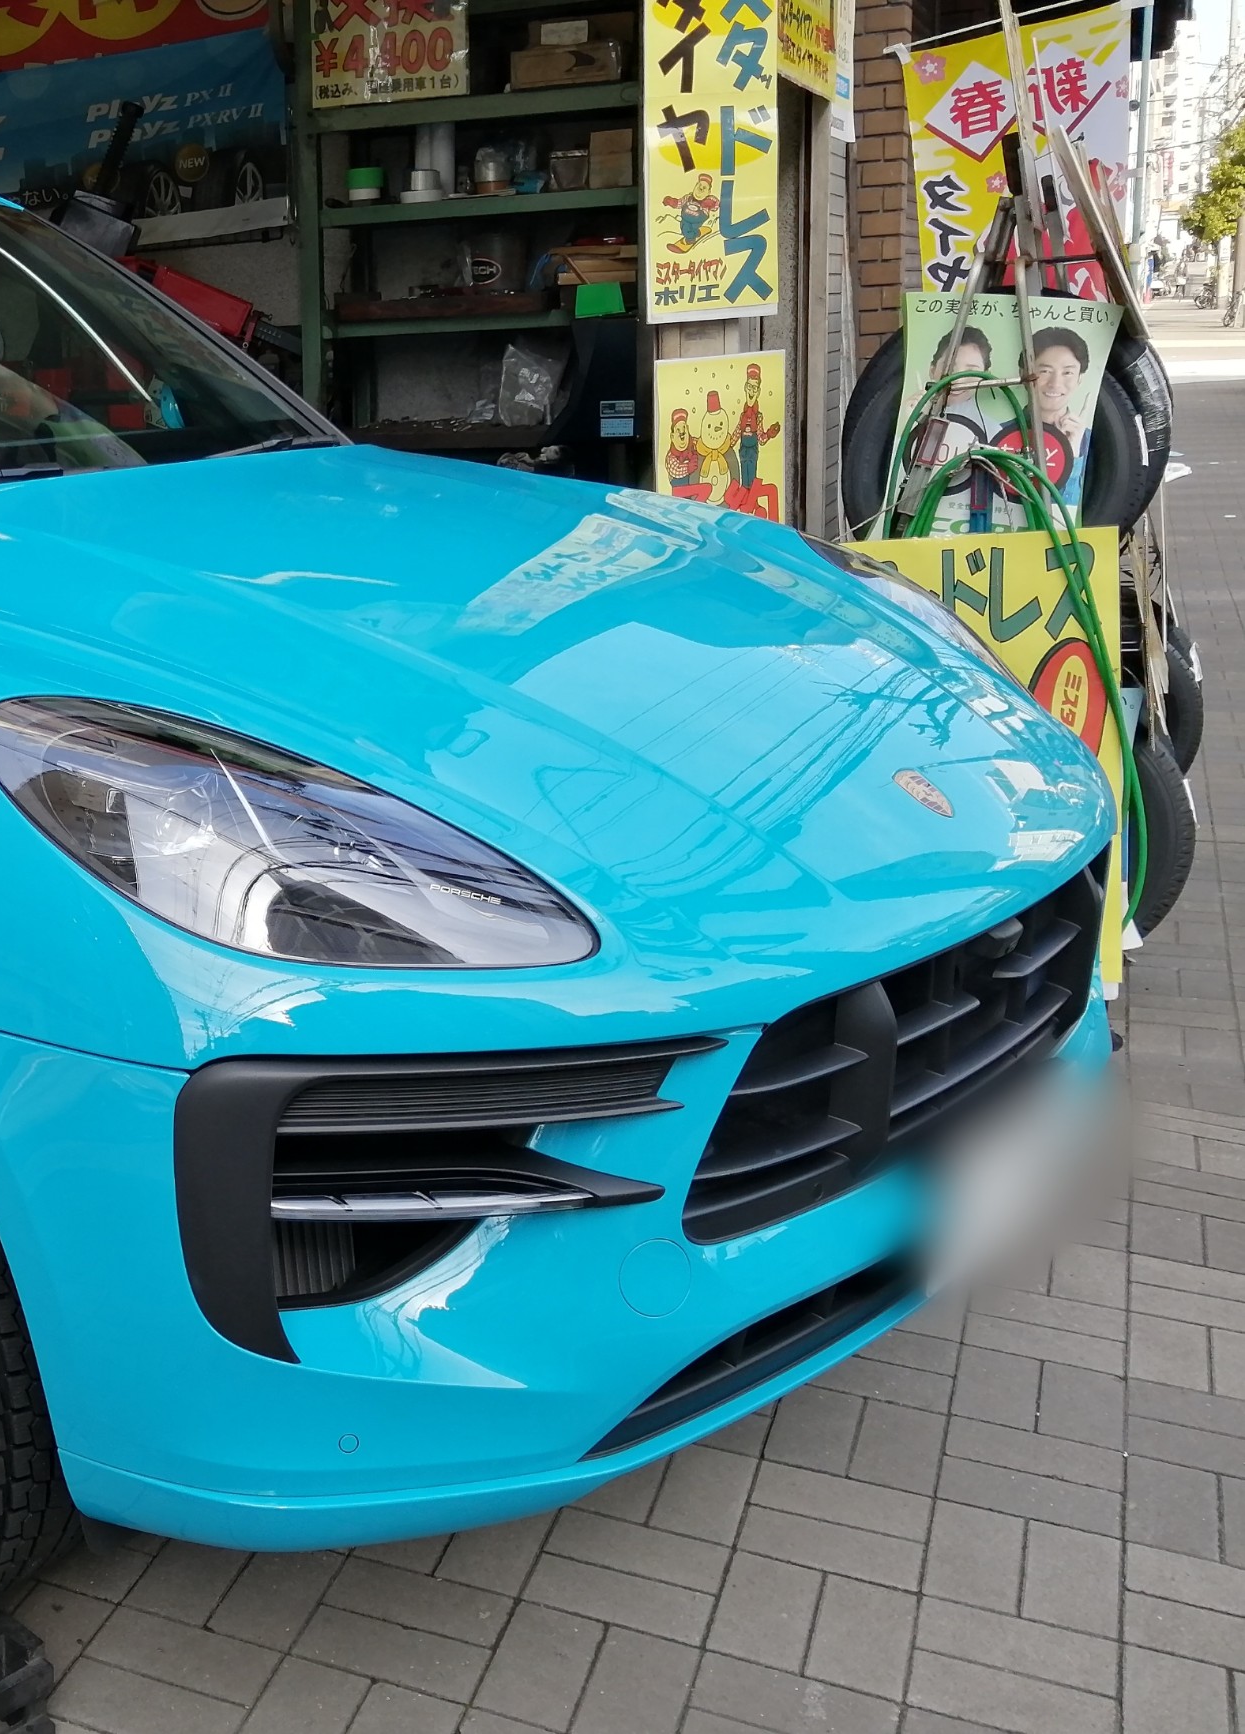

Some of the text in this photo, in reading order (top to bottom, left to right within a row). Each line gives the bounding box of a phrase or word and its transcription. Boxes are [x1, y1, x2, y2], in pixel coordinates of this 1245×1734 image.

[86, 93, 179, 123] Plyz
[184, 88, 214, 107] PX
[179, 156, 206, 169] NEW
[472, 265, 496, 275] ECH
[656, 257, 727, 285] ミスタータイヤマン
[655, 284, 721, 306] ホリエ
[930, 542, 1095, 643] ドレス
[1061, 671, 1082, 728] ミスタ
[429, 883, 502, 905] PORSCHE
